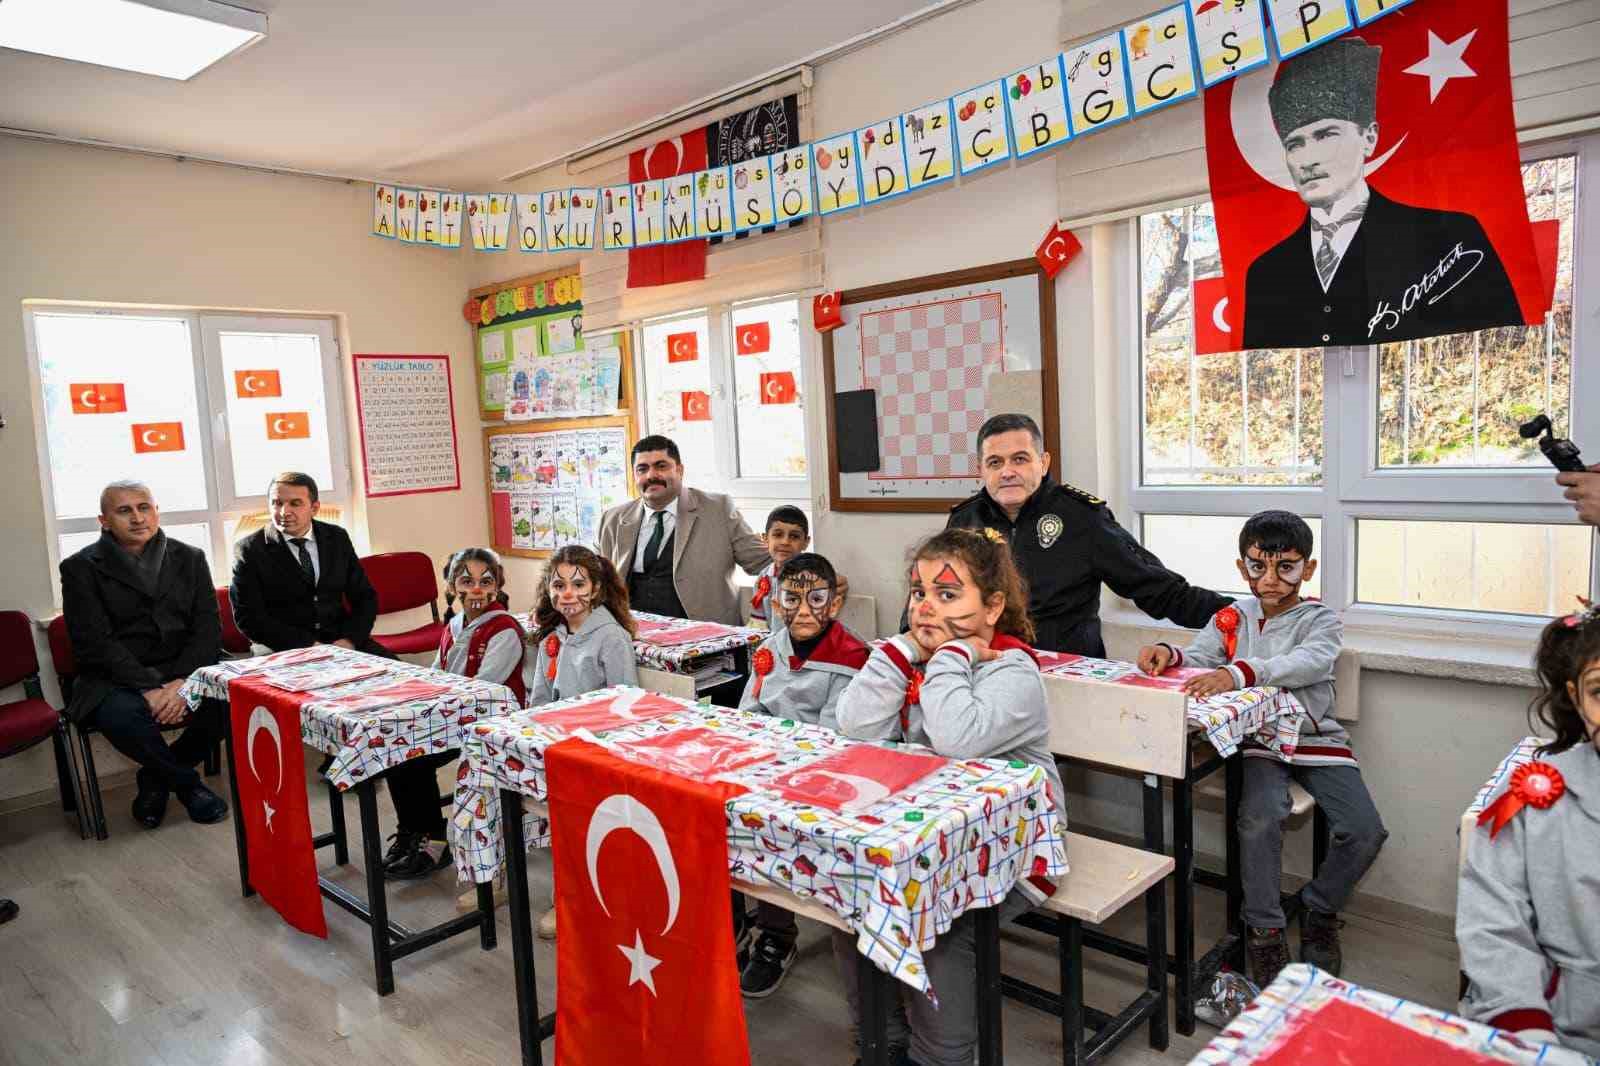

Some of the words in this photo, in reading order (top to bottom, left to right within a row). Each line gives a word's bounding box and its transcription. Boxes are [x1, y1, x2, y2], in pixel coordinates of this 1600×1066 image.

[378, 215, 389, 234] A
[400, 218, 410, 240] N
[425, 220, 433, 242] E
[446, 223, 454, 245] T
[493, 225, 500, 247] L
[523, 226, 537, 249] O
[554, 223, 566, 248] K
[576, 222, 587, 246] U
[613, 222, 623, 246] R
[670, 211, 688, 239] M
[706, 199, 722, 233] Ü
[747, 198, 760, 225] S
[782, 179, 802, 216] Ö
[827, 177, 845, 208] Y
[875, 166, 895, 197] D
[919, 147, 939, 182] Z
[972, 128, 994, 163] Ç
[1031, 112, 1051, 147] B
[1083, 89, 1114, 124] G
[1147, 63, 1178, 100] C
[1221, 31, 1241, 71] Ş
[1299, 1, 1321, 42] P
[586, 199, 593, 209] u
[619, 196, 626, 206] r
[680, 184, 690, 196] m
[716, 173, 724, 189] ü
[755, 169, 763, 181] s
[794, 153, 804, 169] ö
[838, 146, 849, 169] y
[883, 121, 894, 146] d
[931, 115, 942, 130] z
[984, 96, 994, 113] ç
[1039, 65, 1054, 90] b
[1098, 50, 1112, 77] g
[1163, 24, 1177, 40] c
